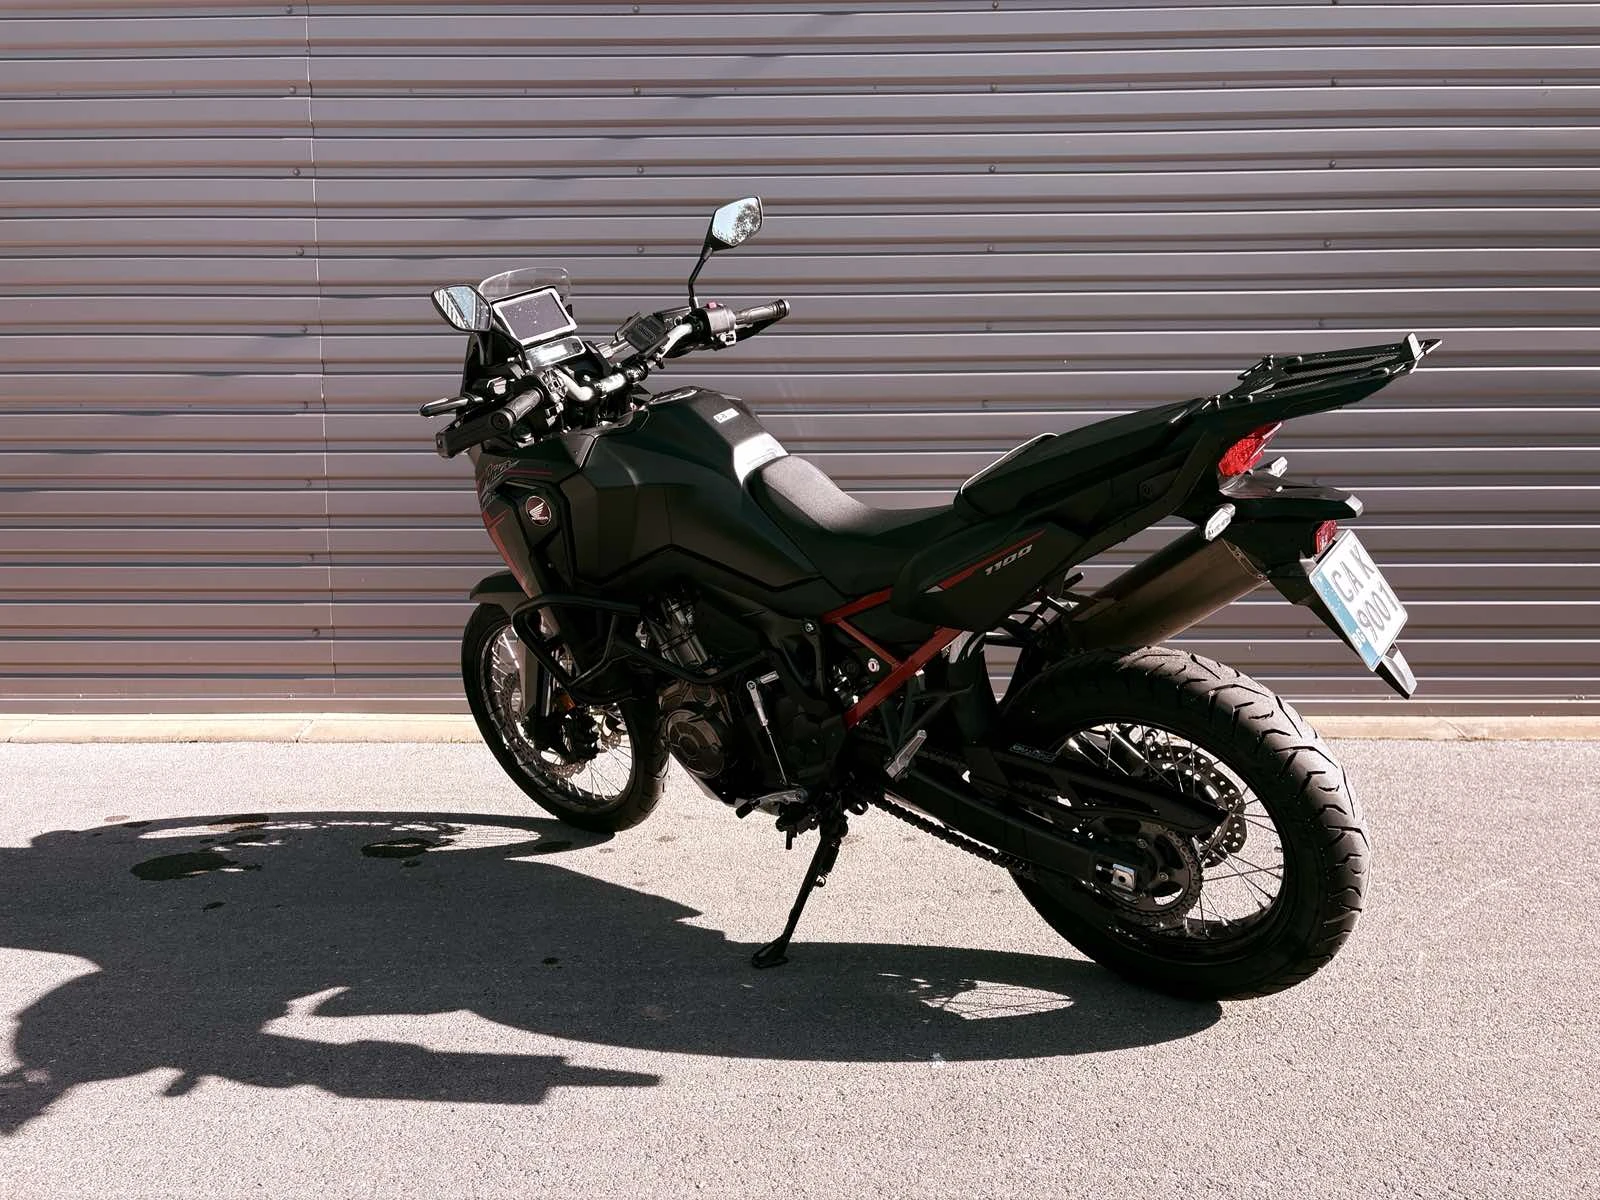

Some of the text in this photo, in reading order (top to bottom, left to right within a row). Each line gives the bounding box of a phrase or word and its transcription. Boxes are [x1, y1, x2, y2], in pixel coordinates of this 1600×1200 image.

[985, 544, 1033, 576] 1100
[1331, 544, 1375, 602] CA K
[1357, 581, 1398, 643] 9001
[1352, 627, 1367, 648] BG
